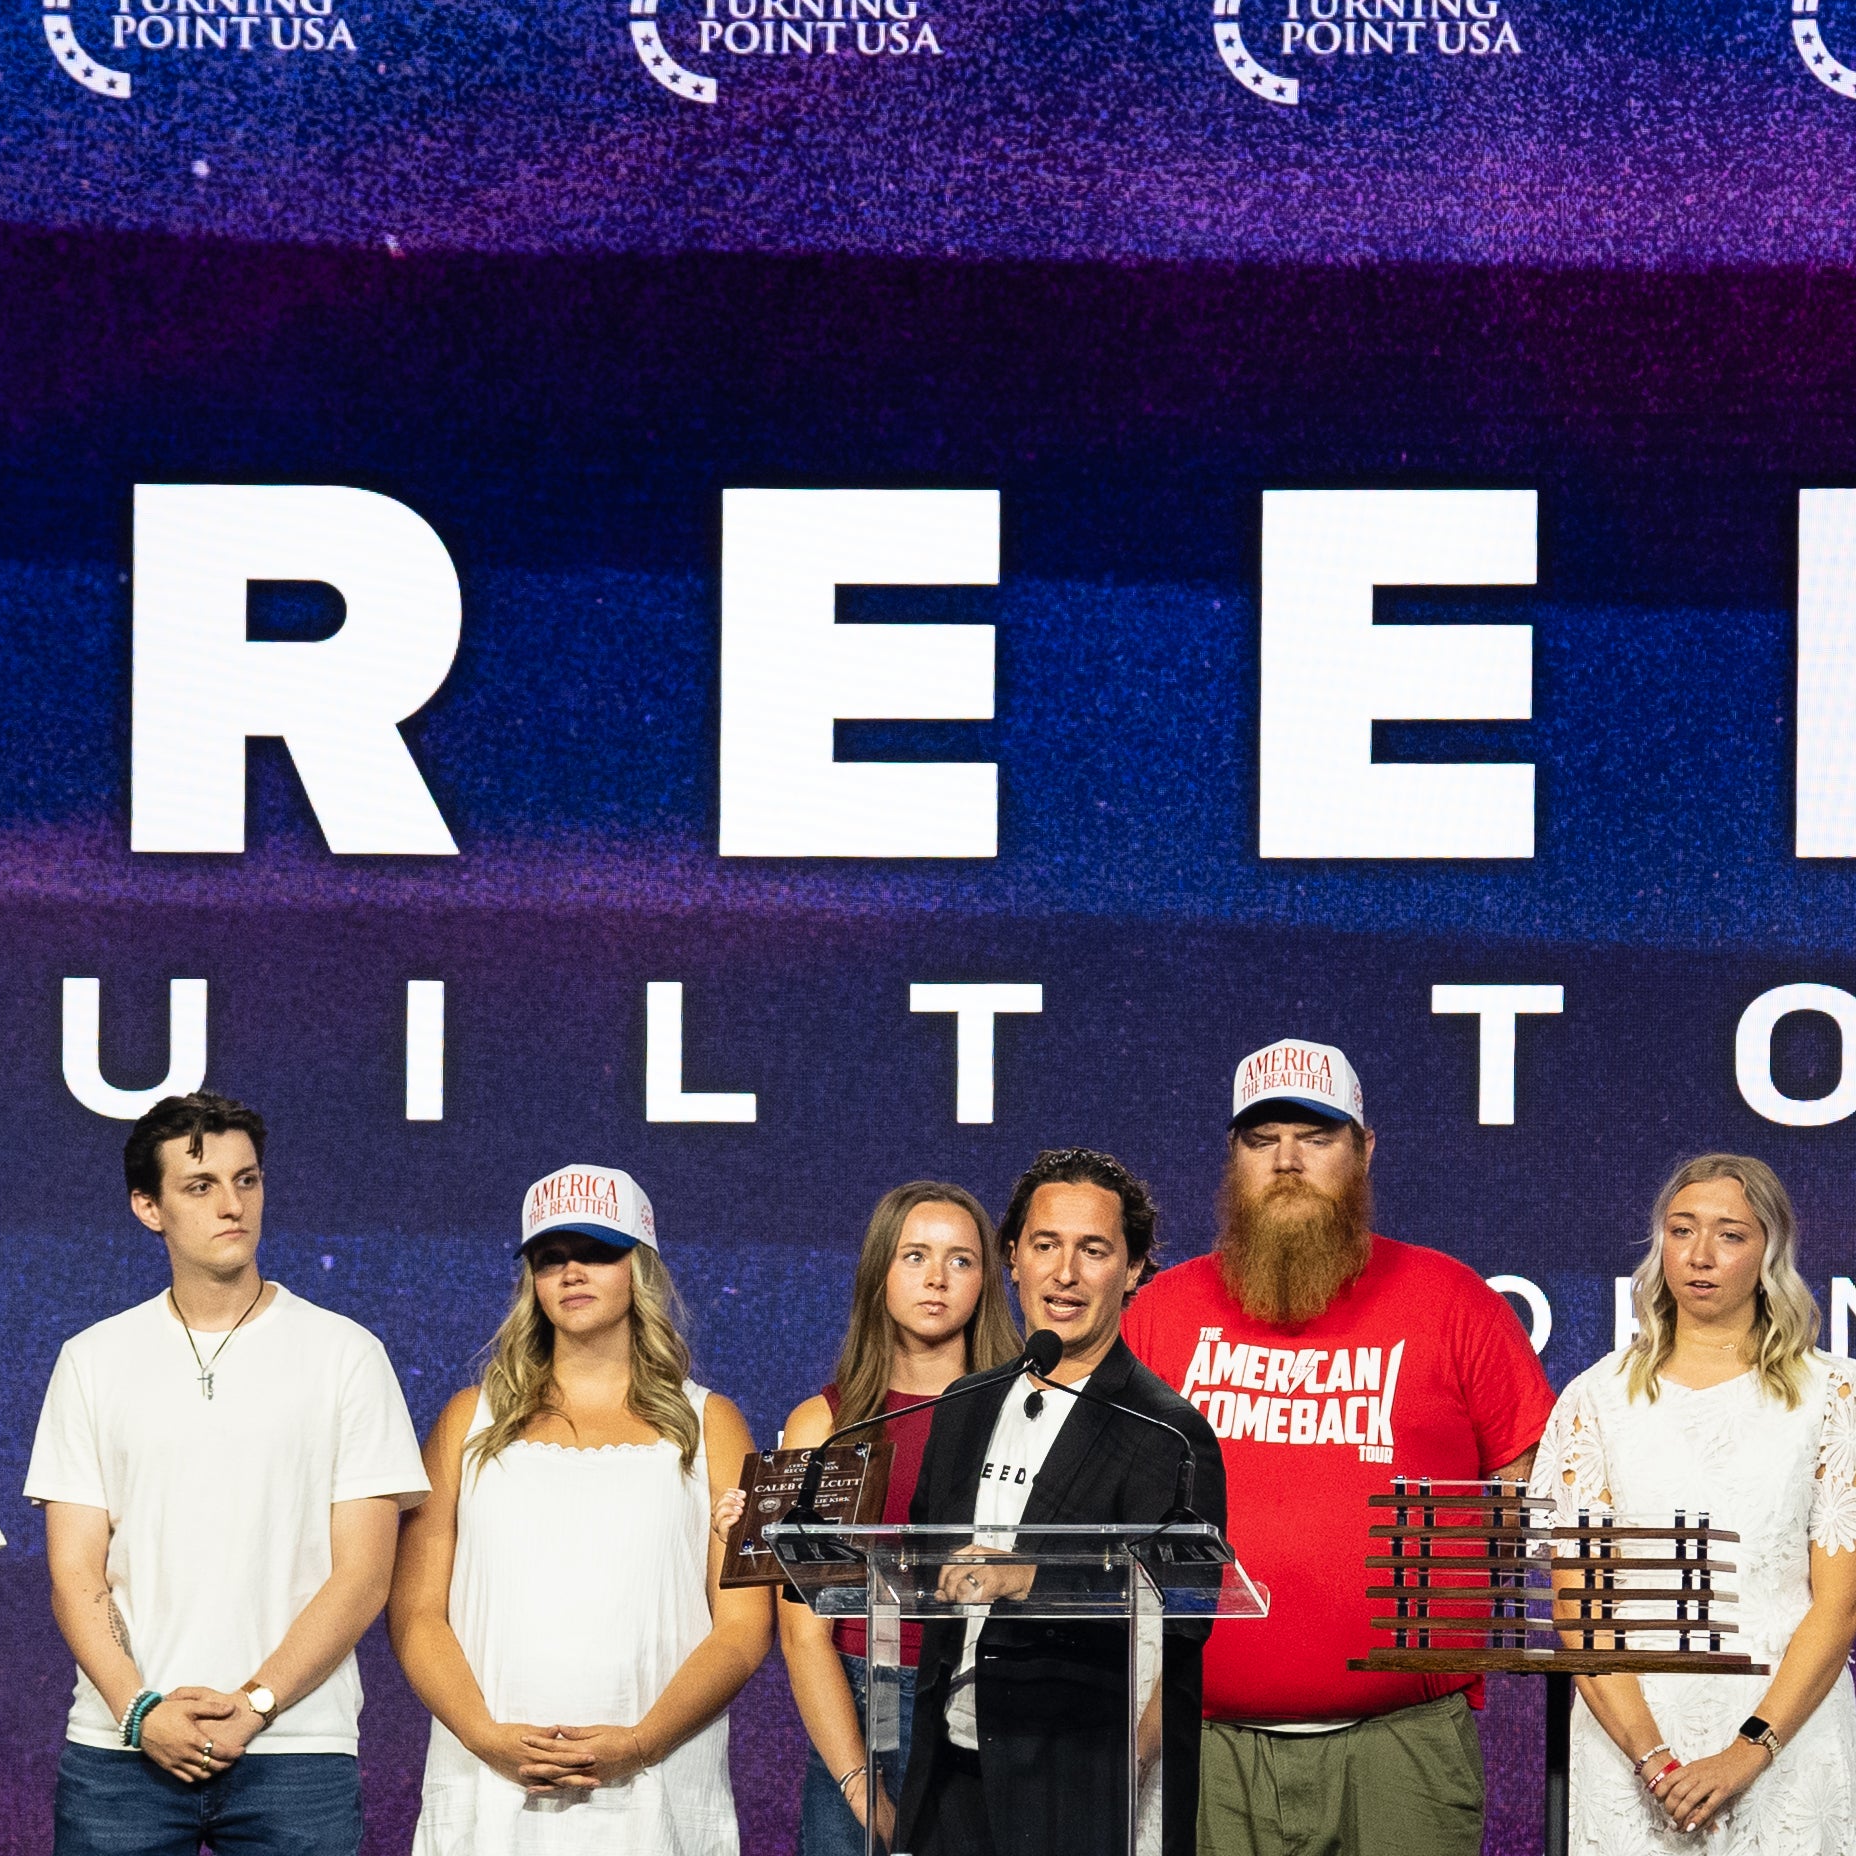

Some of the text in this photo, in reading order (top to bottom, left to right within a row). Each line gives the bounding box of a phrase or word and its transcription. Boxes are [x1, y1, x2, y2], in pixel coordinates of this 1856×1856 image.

[111, 15, 357, 51] POINT USA
[699, 21, 944, 55] POINT USA
[1282, 21, 1521, 54] POINT USA
[1245, 1047, 1332, 1084] AMERICA
[1241, 1072, 1335, 1103] THE BEAUTIFUL
[531, 1174, 618, 1211] AMERICA
[529, 1198, 620, 1229] THE BEAUTIFUL
[1199, 1327, 1223, 1341] THE
[1180, 1341, 1382, 1400] AMERICAN
[1358, 1445, 1394, 1464] TOUR
[754, 1482, 795, 1493] CALEB
